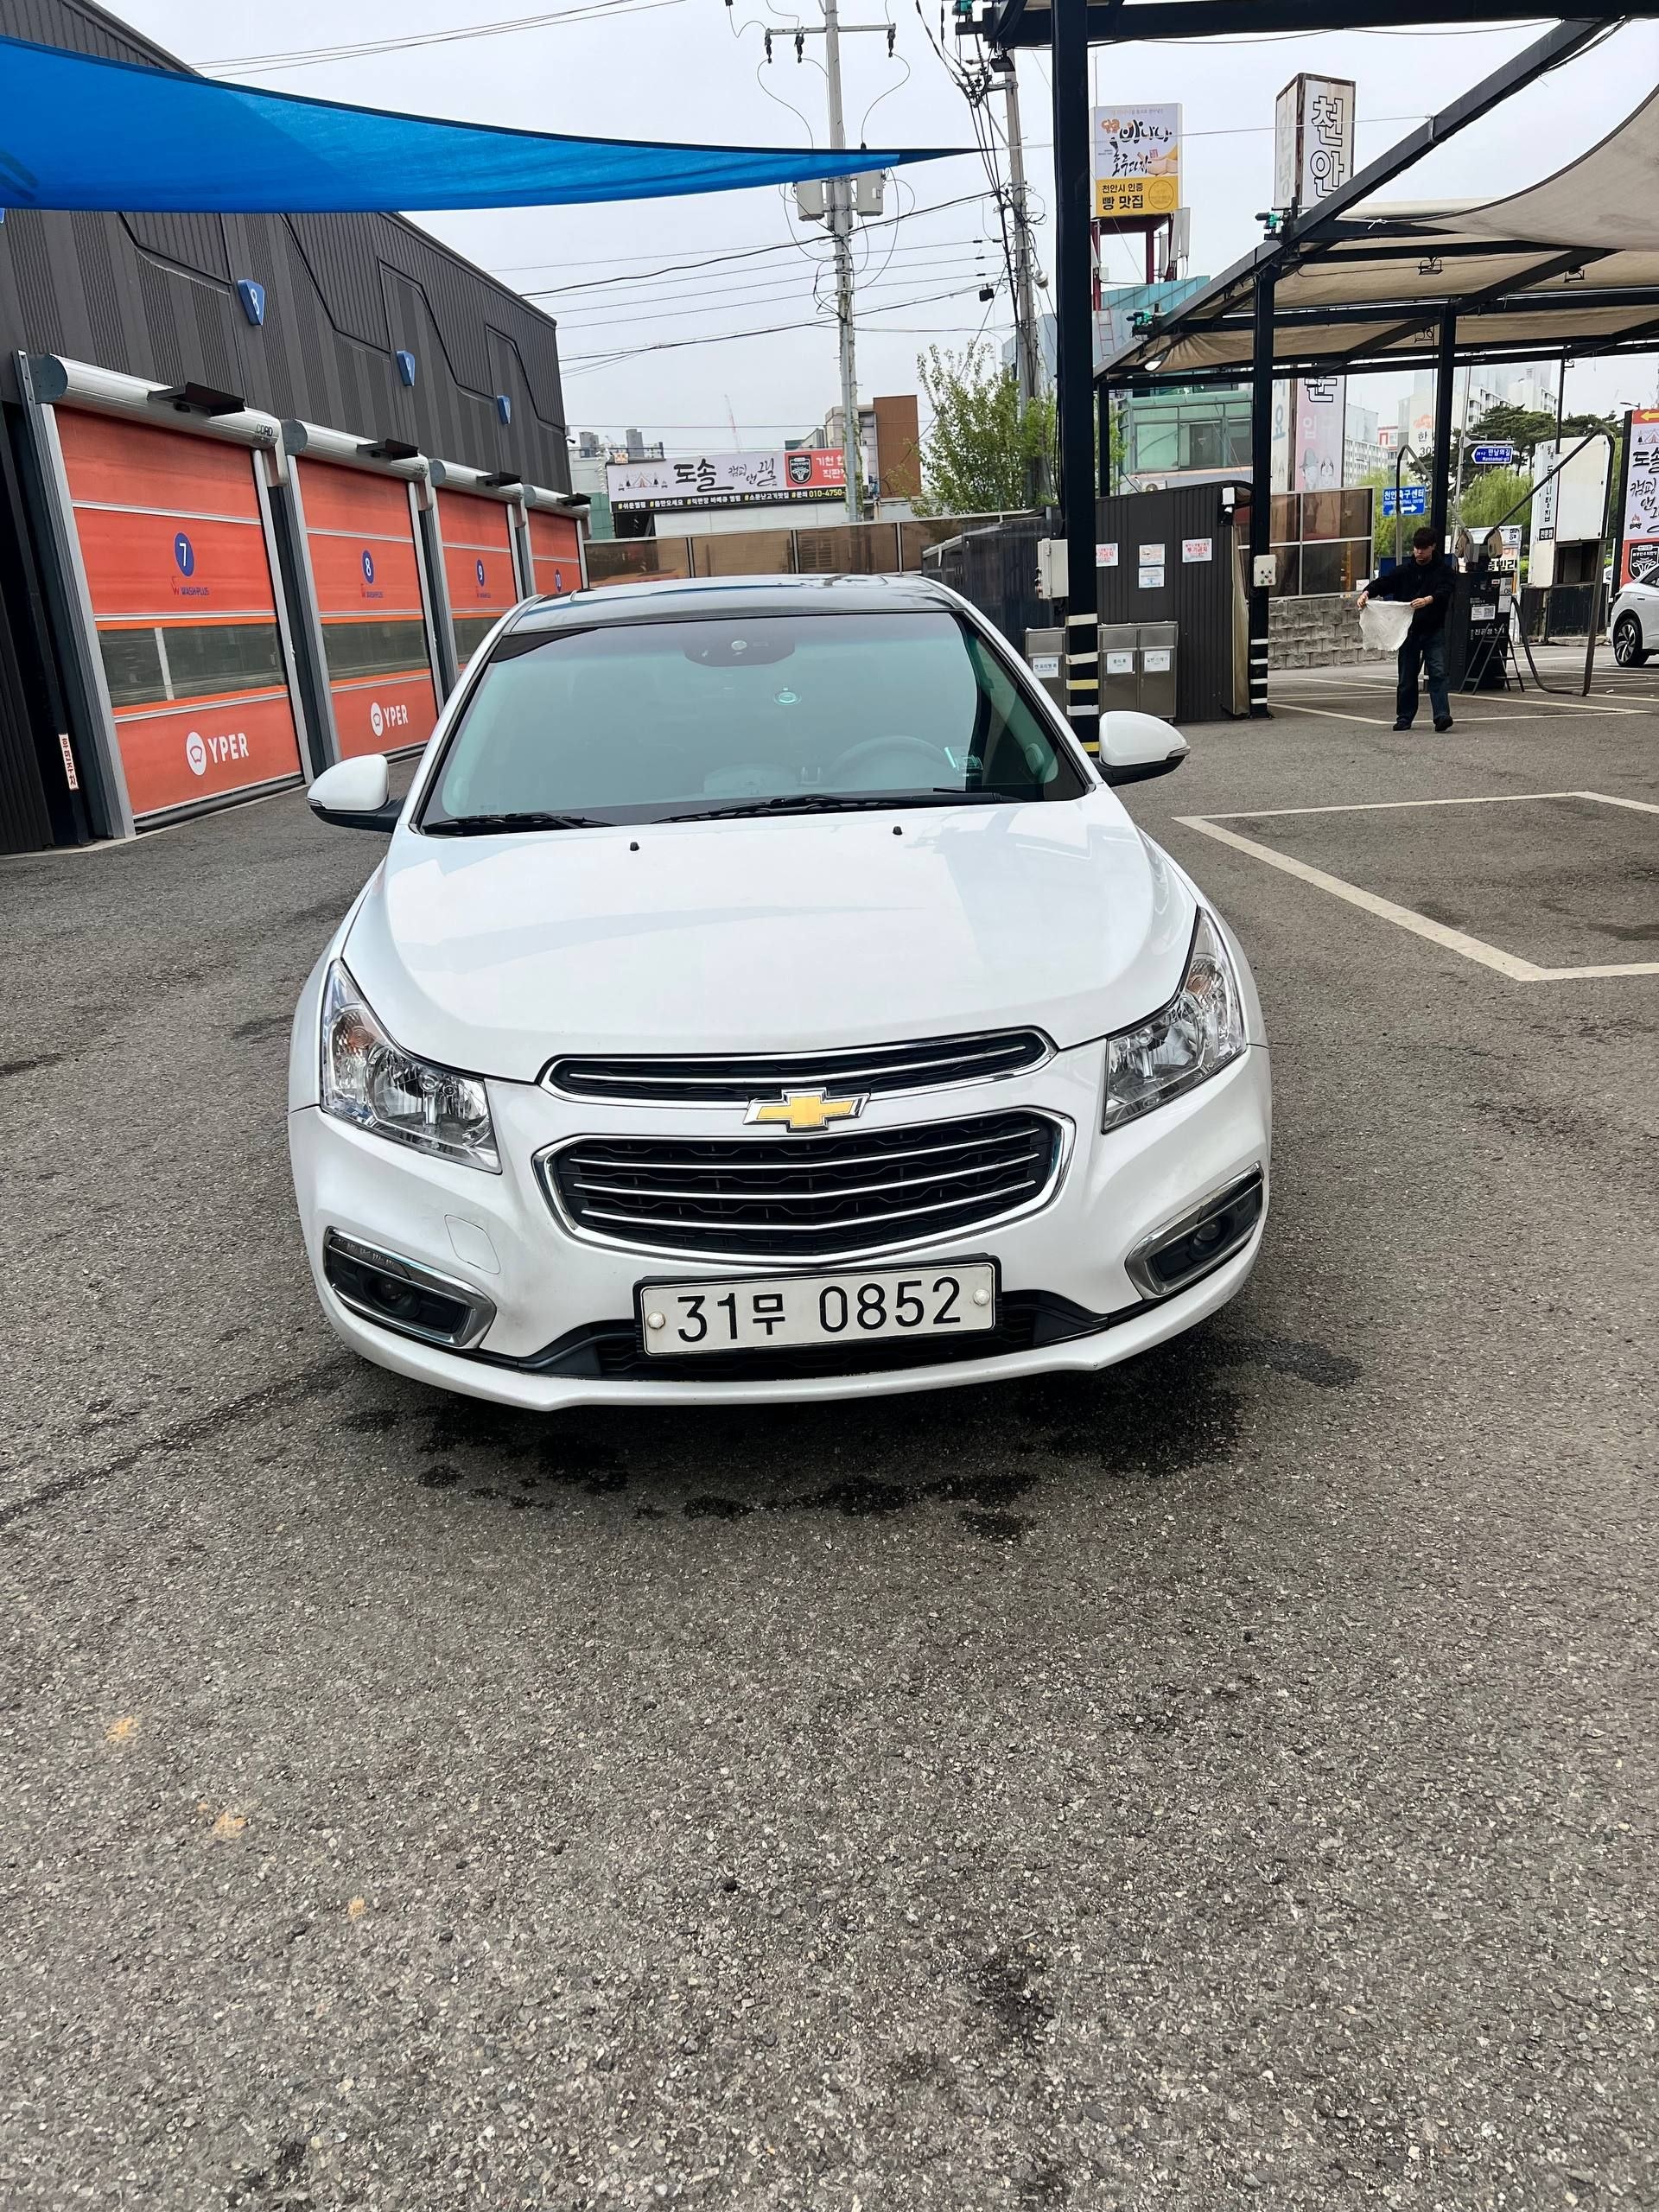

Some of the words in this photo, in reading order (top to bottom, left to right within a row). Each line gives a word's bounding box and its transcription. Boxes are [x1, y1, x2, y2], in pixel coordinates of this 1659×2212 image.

[1309, 95, 1344, 198] 천안
[1102, 196, 1115, 210] 빵
[1119, 195, 1143, 209] 맛집
[251, 289, 260, 315] 8
[673, 458, 734, 493] 도솔
[809, 488, 846, 498] 010-4750-
[365, 557, 372, 576] 8
[383, 704, 409, 728] YPER
[207, 732, 250, 764] YPER
[677, 1292, 786, 1343] 31무
[818, 1276, 962, 1333] 0852
